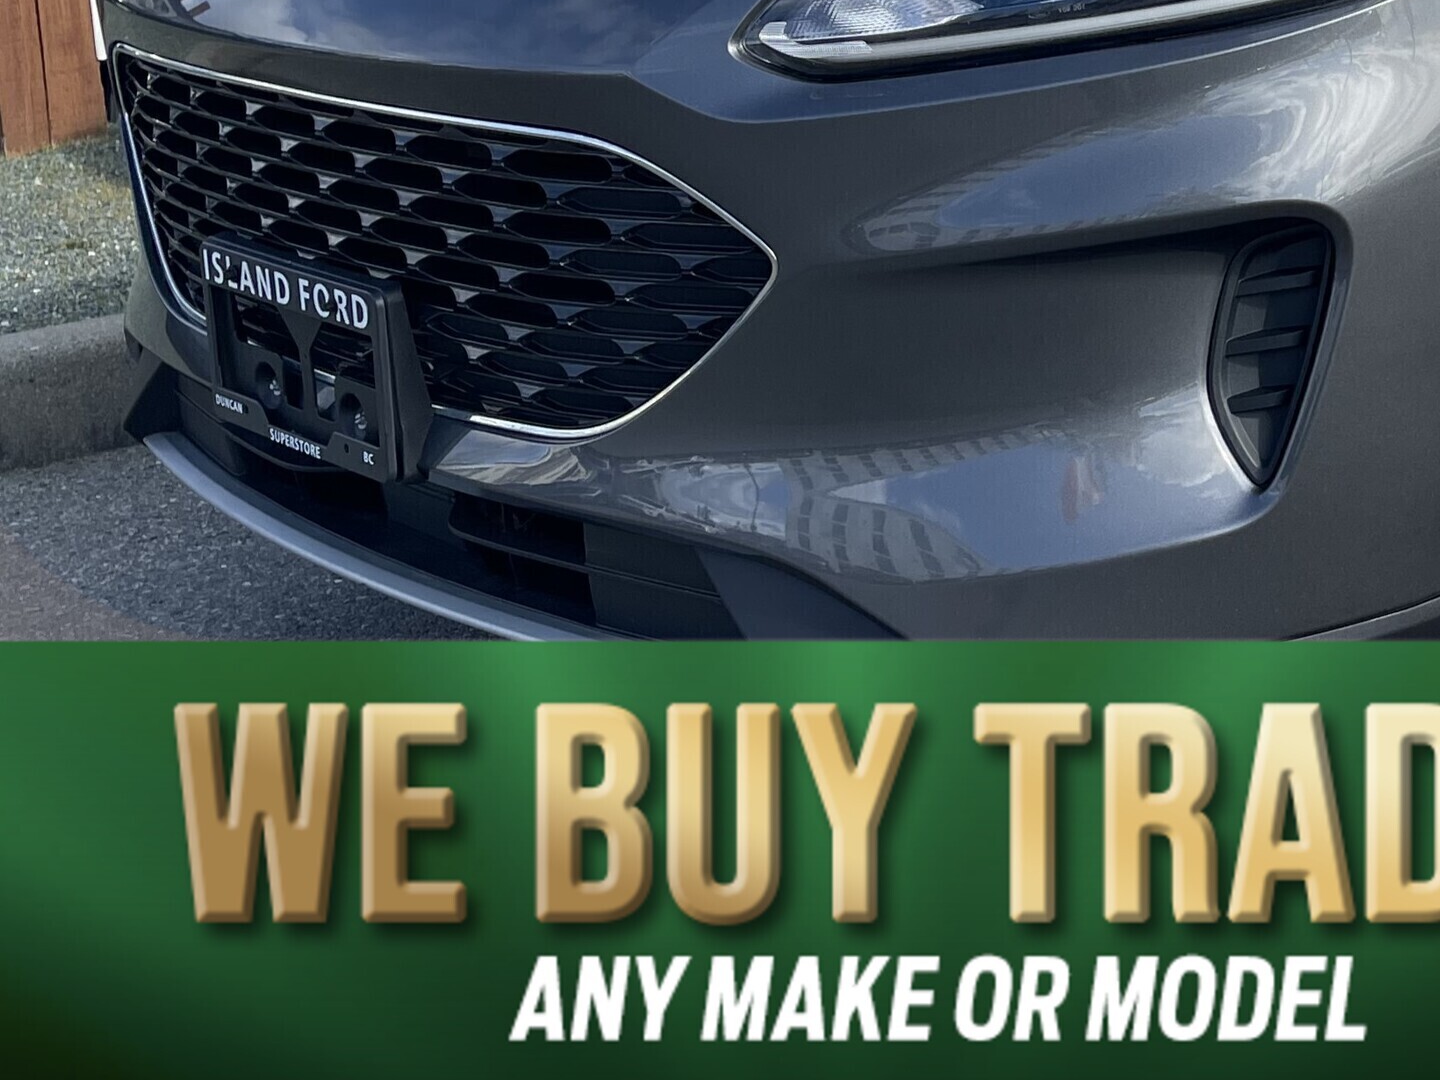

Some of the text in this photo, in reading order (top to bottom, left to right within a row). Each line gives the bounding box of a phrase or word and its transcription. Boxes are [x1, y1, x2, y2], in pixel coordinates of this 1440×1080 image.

[298, 278, 369, 330] FORD
[215, 393, 243, 414] DUNCAN
[269, 428, 321, 460] SUPERSTORE
[363, 451, 375, 466] BC
